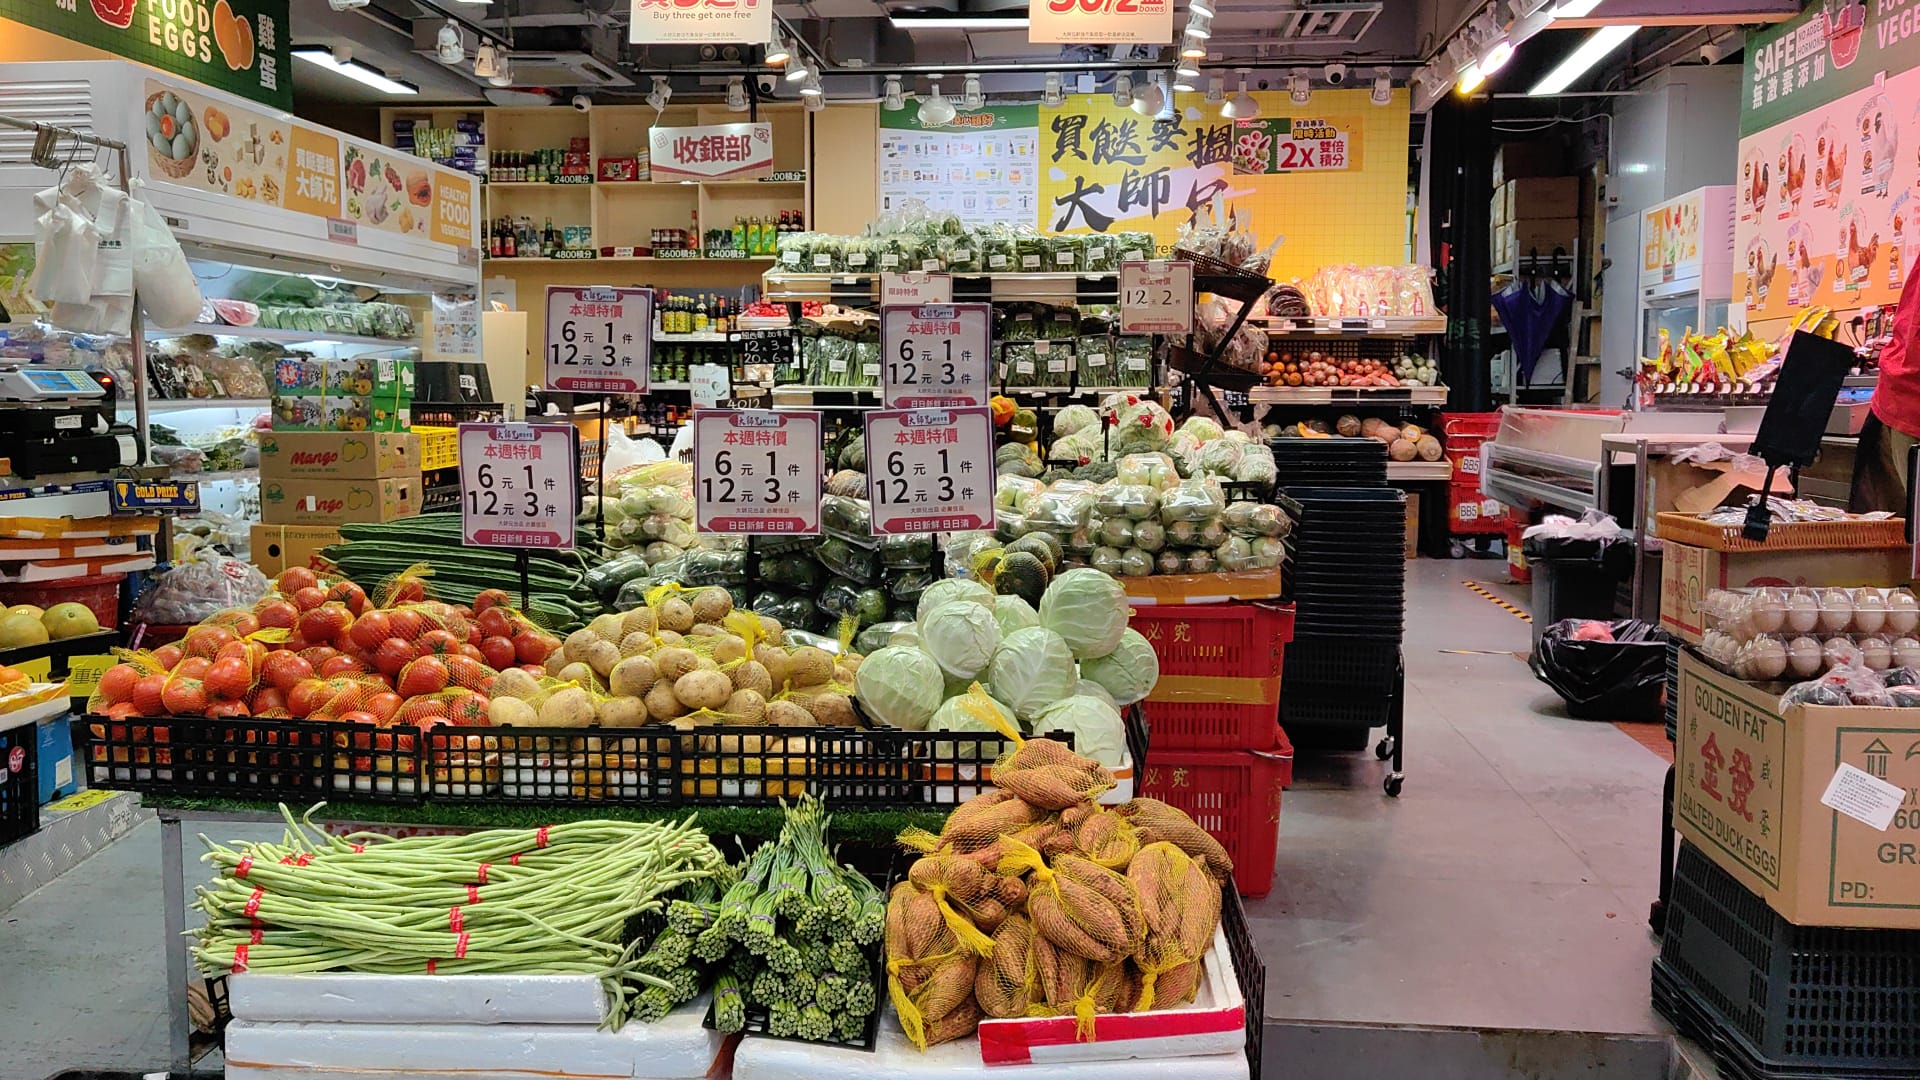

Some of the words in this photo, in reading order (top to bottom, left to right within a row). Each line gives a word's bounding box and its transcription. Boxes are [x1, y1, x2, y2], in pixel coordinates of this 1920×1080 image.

[653, 11, 669, 21] Buy
[673, 11, 696, 19] three
[698, 12, 713, 20] get
[734, 10, 751, 19] free
[1139, 5, 1165, 13] boxes
[1878, 4, 1920, 49] VEGE
[149, 15, 212, 63] EGGS
[1754, 31, 1795, 82] SAFE
[673, 135, 751, 164] 收銀部
[1320, 141, 1344, 153] 雙倍
[1320, 154, 1344, 166] 積分
[554, 175, 589, 183] 2400積分
[439, 184, 470, 204] HEALTHY
[440, 201, 470, 225] FOOD
[659, 250, 697, 258] 5600積分
[708, 250, 746, 258] 6400積分
[1126, 289, 1148, 305] 12
[1161, 290, 1172, 305] 2
[569, 304, 623, 318] 本週特價
[562, 320, 576, 342] 6
[584, 332, 594, 343] 元
[604, 322, 613, 344] 1
[622, 333, 632, 344] 件
[907, 321, 960, 335] 本週特價
[551, 343, 578, 365] 12
[582, 355, 593, 365] 元
[602, 345, 616, 367] 3
[622, 356, 632, 366] 件
[744, 353, 761, 363] 20
[772, 353, 781, 362] 6
[900, 339, 914, 361] 6
[922, 350, 932, 361] 元
[942, 339, 952, 360] 1
[961, 350, 972, 361] 件
[888, 363, 917, 385] 12
[922, 373, 932, 384] 元
[941, 363, 955, 385] 3
[961, 374, 971, 384] 件
[723, 430, 787, 446] 本週特價
[894, 428, 958, 445] 本週特價
[290, 452, 338, 466] Mango
[484, 444, 542, 460] 本週特價
[715, 450, 732, 475] 6
[741, 464, 753, 475] 元
[766, 451, 776, 475] 1
[787, 464, 800, 476] 件
[887, 451, 904, 476] 6
[913, 463, 926, 475] 元
[937, 449, 949, 473] 1
[960, 460, 973, 473] 件
[1462, 458, 1479, 471] BB5
[478, 464, 493, 489] 6
[502, 477, 514, 489] 元
[523, 465, 533, 489] 1
[544, 478, 555, 490] 件
[135, 486, 154, 498] GOLD
[156, 486, 179, 498] PRIZE
[702, 478, 735, 502] 12
[741, 491, 753, 502] 元
[764, 478, 781, 503] 3
[787, 490, 800, 502] 件
[875, 478, 910, 504] 12
[915, 490, 927, 502] 元
[938, 476, 954, 501] 3
[961, 487, 974, 500] 件
[296, 499, 344, 513] Mngo
[468, 490, 499, 515] 12
[503, 503, 514, 515] 元
[523, 492, 539, 517] 3
[545, 504, 556, 517] 件
[1460, 505, 1477, 517] BB5
[1146, 621, 1192, 642] 必究
[1695, 685, 1740, 735] GOLDEN
[1744, 711, 1767, 744] FAT
[1144, 768, 1189, 788] 必究
[1682, 792, 1714, 832] SALTED
[1716, 819, 1743, 854] DUCK
[1745, 841, 1777, 878] EGGS
[1877, 842, 1920, 865] GR
[1840, 881, 1874, 899] PD:
